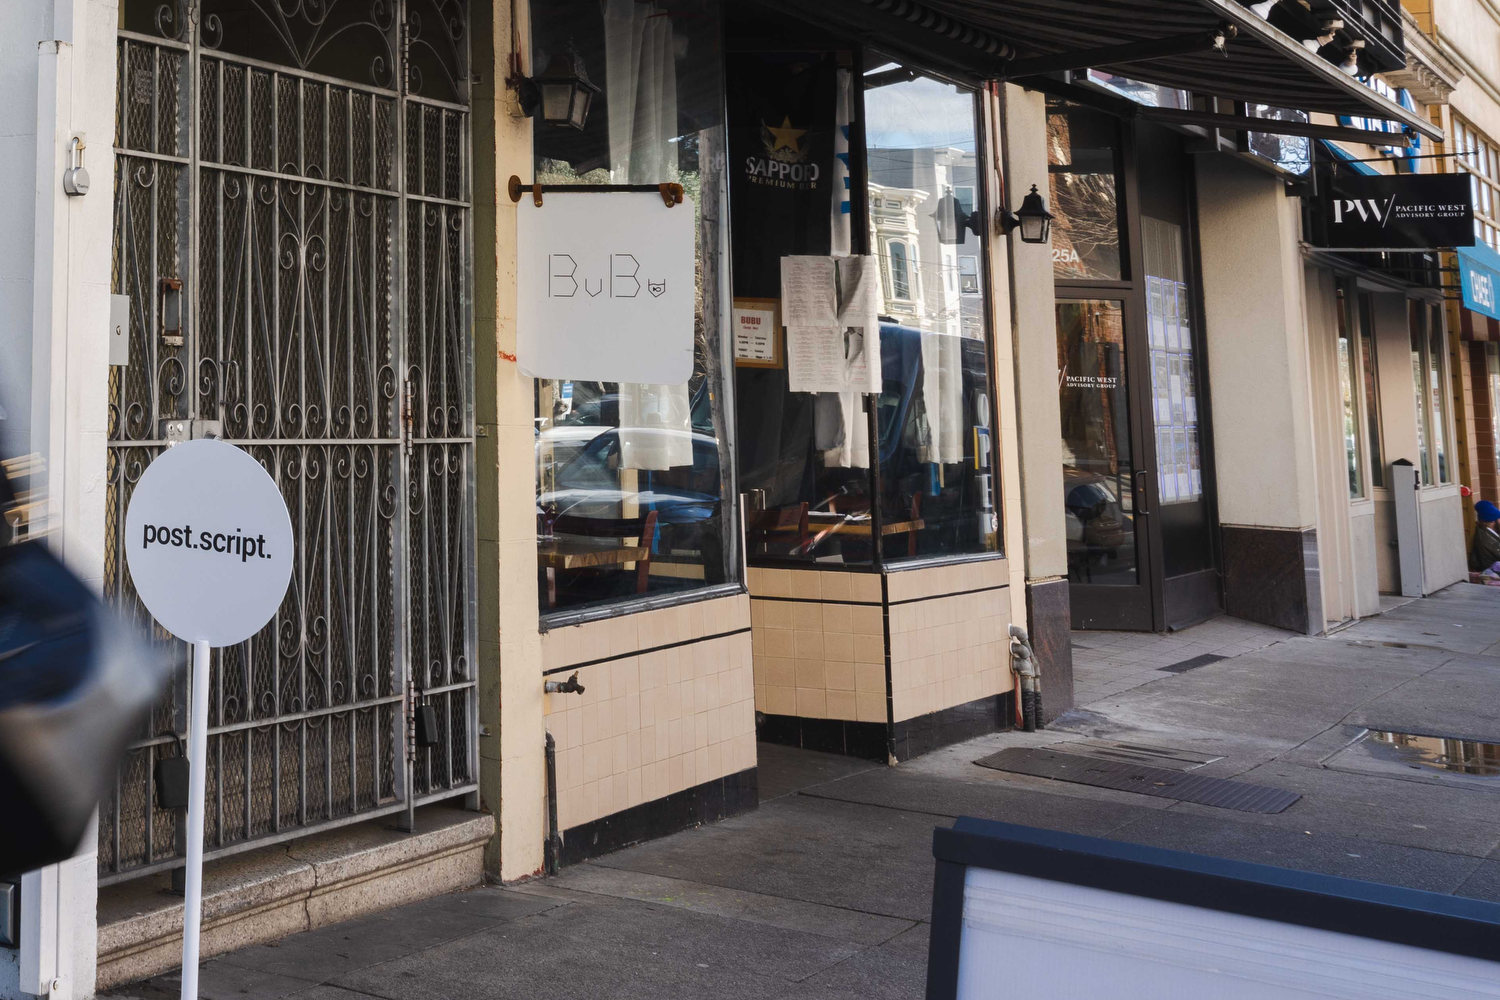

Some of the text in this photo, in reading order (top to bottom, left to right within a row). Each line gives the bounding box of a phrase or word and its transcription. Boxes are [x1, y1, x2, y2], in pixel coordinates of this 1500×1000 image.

[1395, 204, 1436, 212] PACIFIC
[1438, 203, 1467, 212] WEST
[1051, 248, 1080, 263] 25A
[740, 316, 762, 326] BUBU
[1066, 375, 1117, 384] PACIFIC WEST
[143, 523, 272, 563] post.script.
